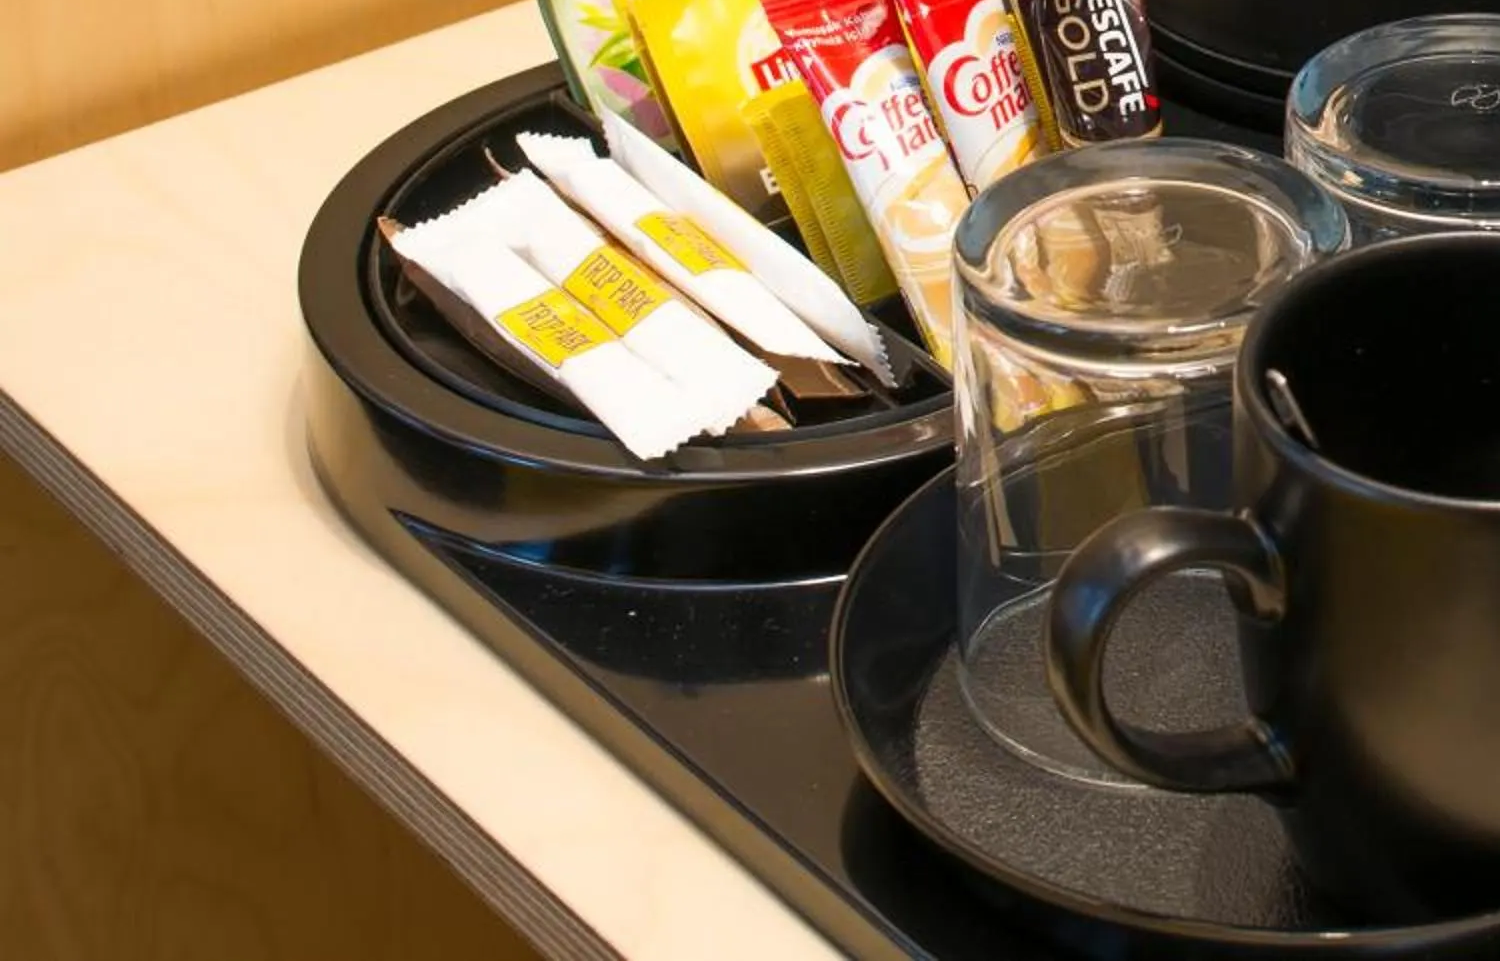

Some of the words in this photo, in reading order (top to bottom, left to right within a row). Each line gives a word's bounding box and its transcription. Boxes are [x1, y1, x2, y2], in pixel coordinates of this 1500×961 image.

[943, 51, 1022, 117] Coffe
[581, 254, 622, 289] TRIP
[607, 275, 656, 319] PARK
